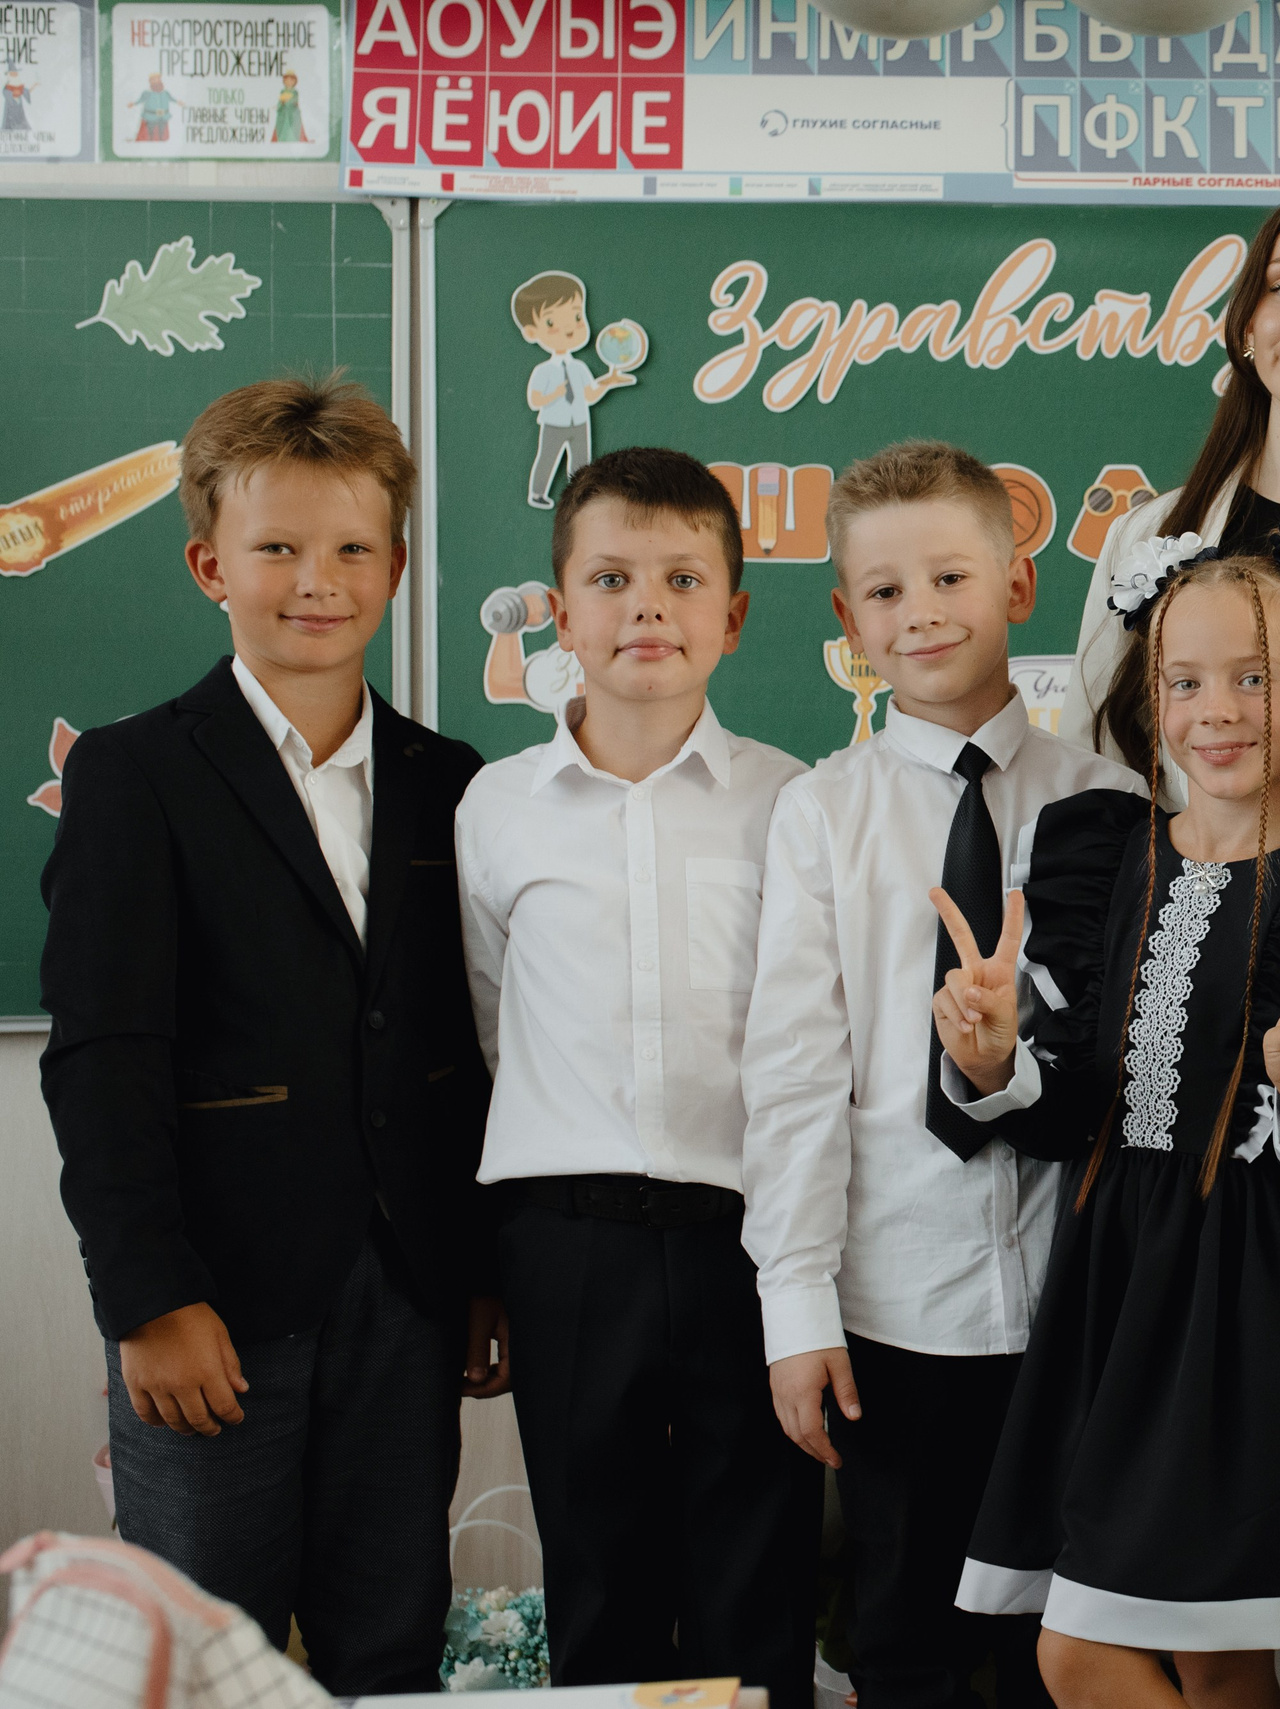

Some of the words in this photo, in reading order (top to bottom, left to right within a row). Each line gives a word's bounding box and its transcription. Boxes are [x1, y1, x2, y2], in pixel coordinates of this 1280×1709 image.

[0, 5, 56, 35] ЁННОЕ
[131, 17, 317, 48] НЕРАСПРОСТРАНЁННОЕ
[159, 48, 288, 78] ПРЕДЛОЖЕНИЕ
[182, 106, 228, 124] ГЛАВНЫЕ
[234, 106, 270, 125] ЧЛЕНЫ
[792, 118, 848, 130] ГЛУХИЕ
[851, 119, 942, 131] СОГЛАСНЫЕ
[186, 126, 266, 144] ПРЕДЛОЖЕНИЯ
[1132, 176, 1193, 188] ПАРНЫЕ
